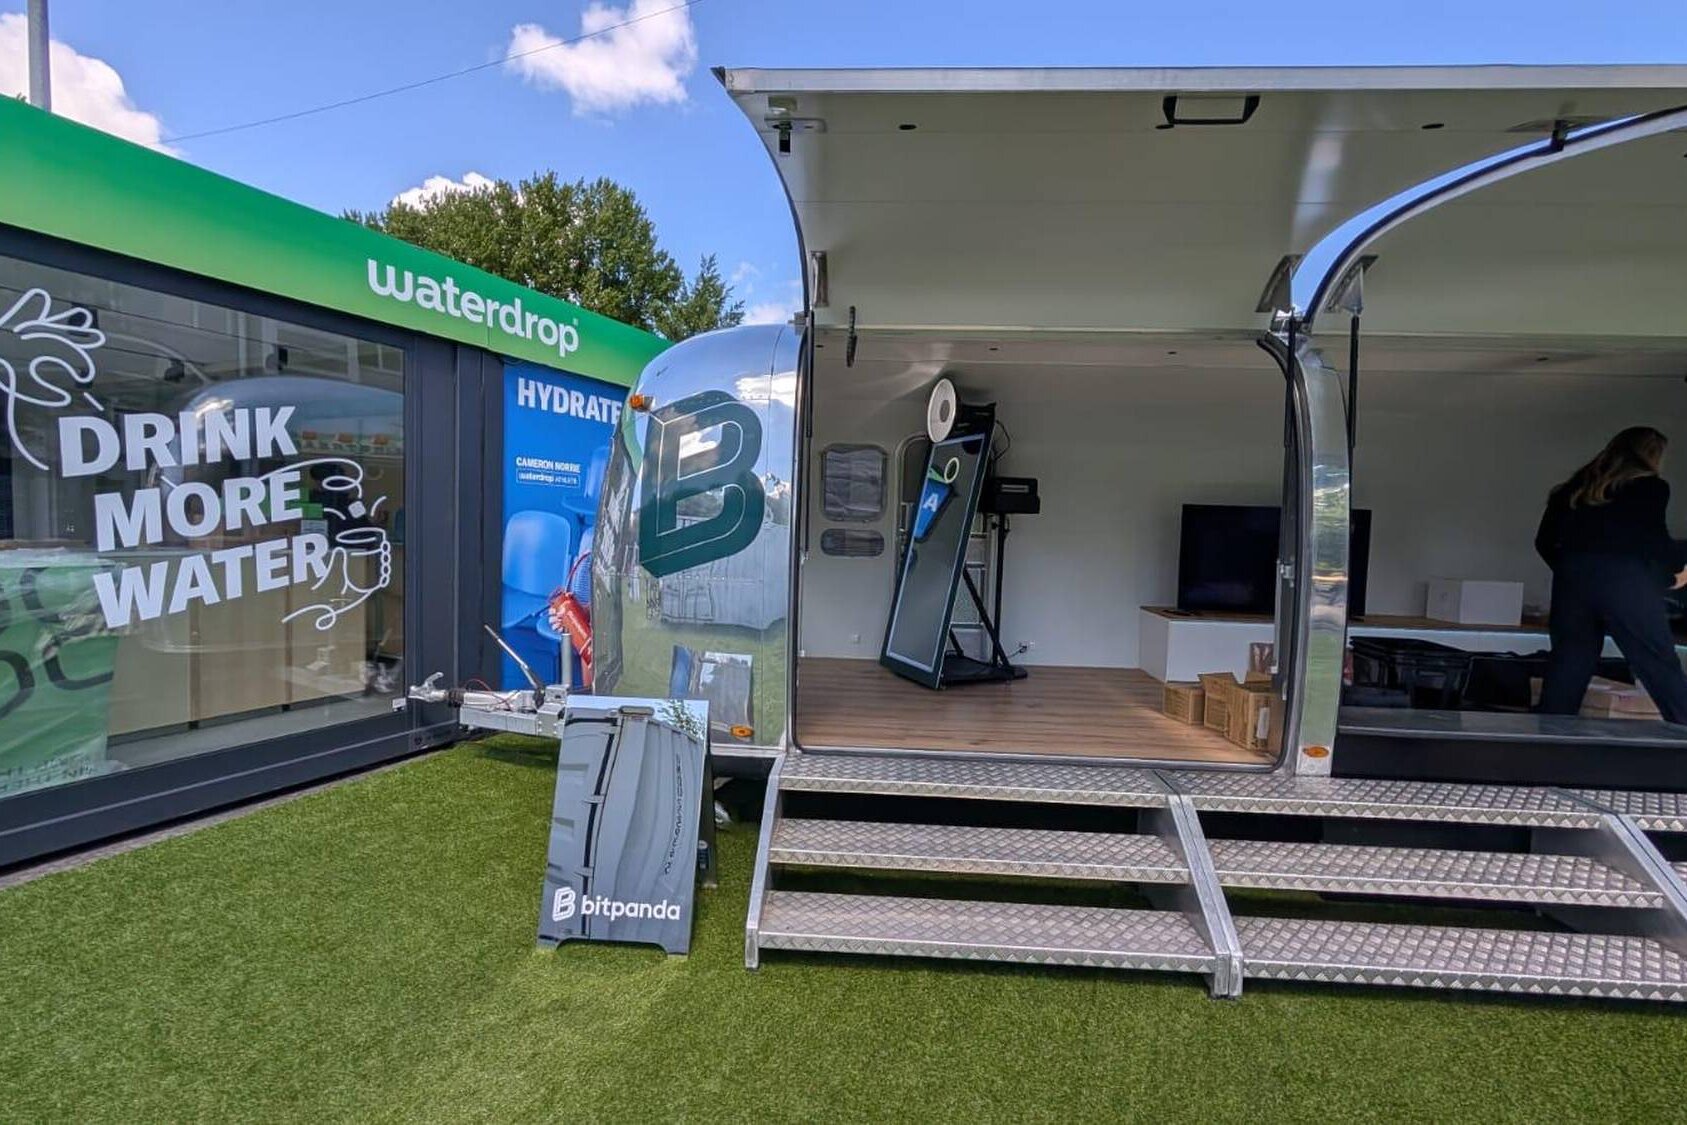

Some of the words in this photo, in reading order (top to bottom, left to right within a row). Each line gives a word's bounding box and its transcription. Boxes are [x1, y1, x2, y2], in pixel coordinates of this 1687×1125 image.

[367, 258, 580, 356] waterdrop
[58, 405, 298, 478] DRINK
[516, 456, 554, 470] CAMERON
[94, 471, 303, 552] MORE
[639, 390, 765, 579] B
[94, 534, 329, 629] WATER
[580, 894, 681, 922] bitpanda
